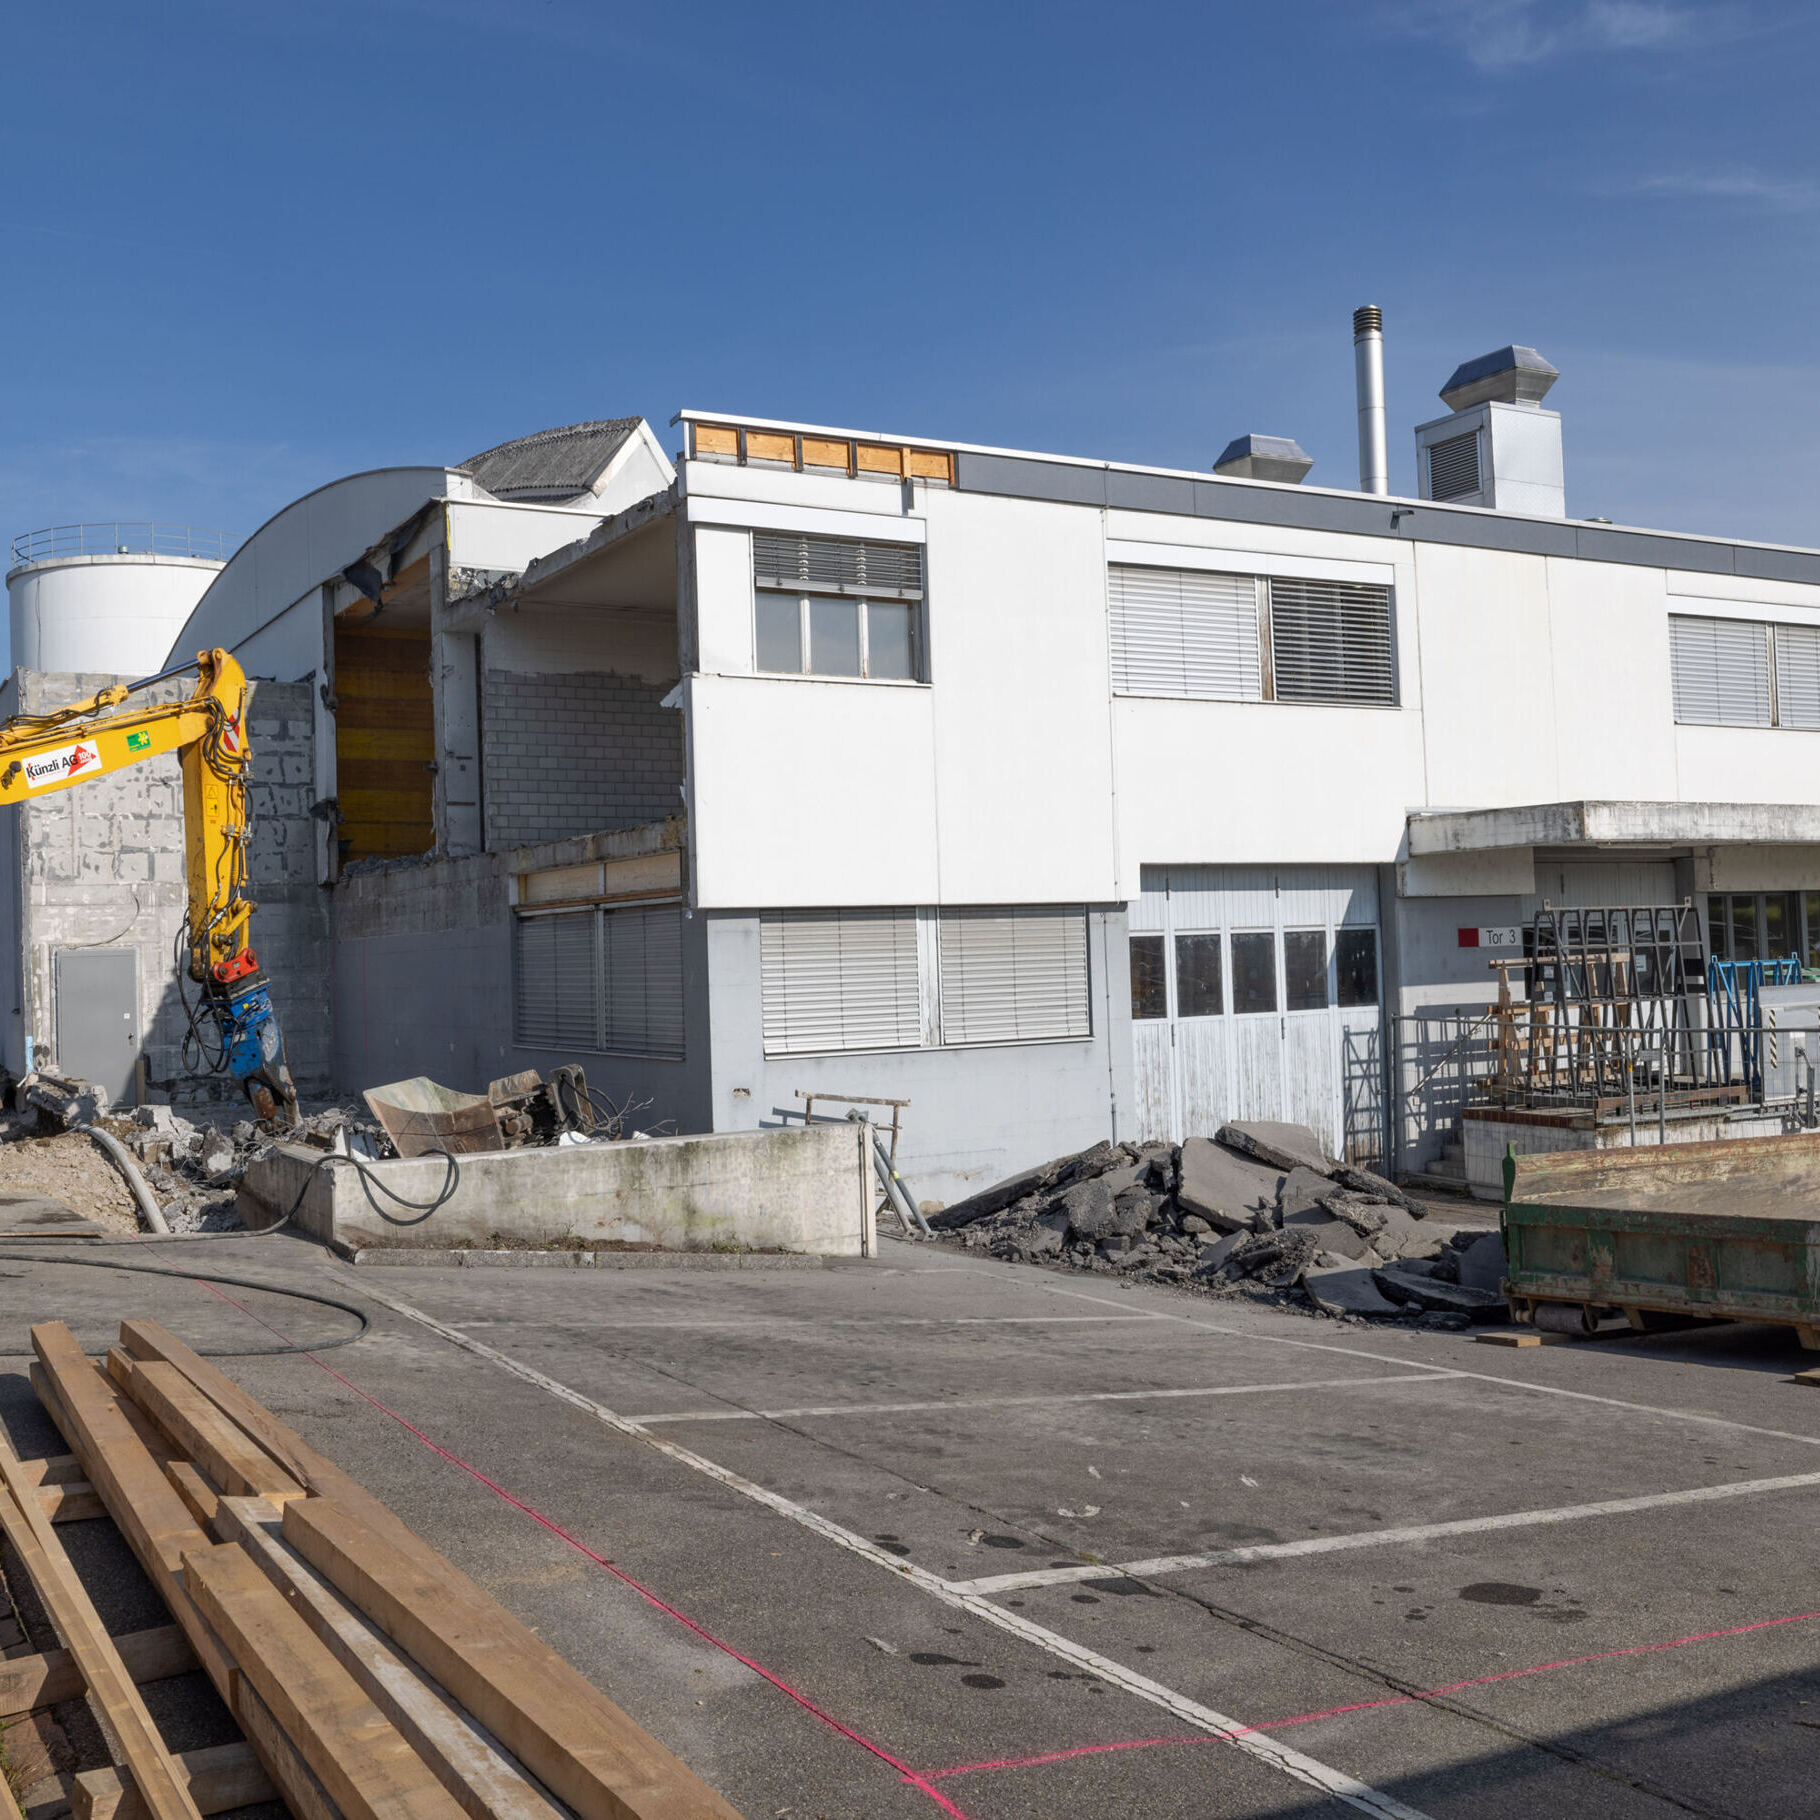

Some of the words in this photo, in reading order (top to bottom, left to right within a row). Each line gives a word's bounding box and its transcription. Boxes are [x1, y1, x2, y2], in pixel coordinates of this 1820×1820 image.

[26, 760, 60, 778] Künzli
[62, 754, 79, 768] AG
[1486, 930, 1503, 944] Tor
[1509, 929, 1516, 944] 3
